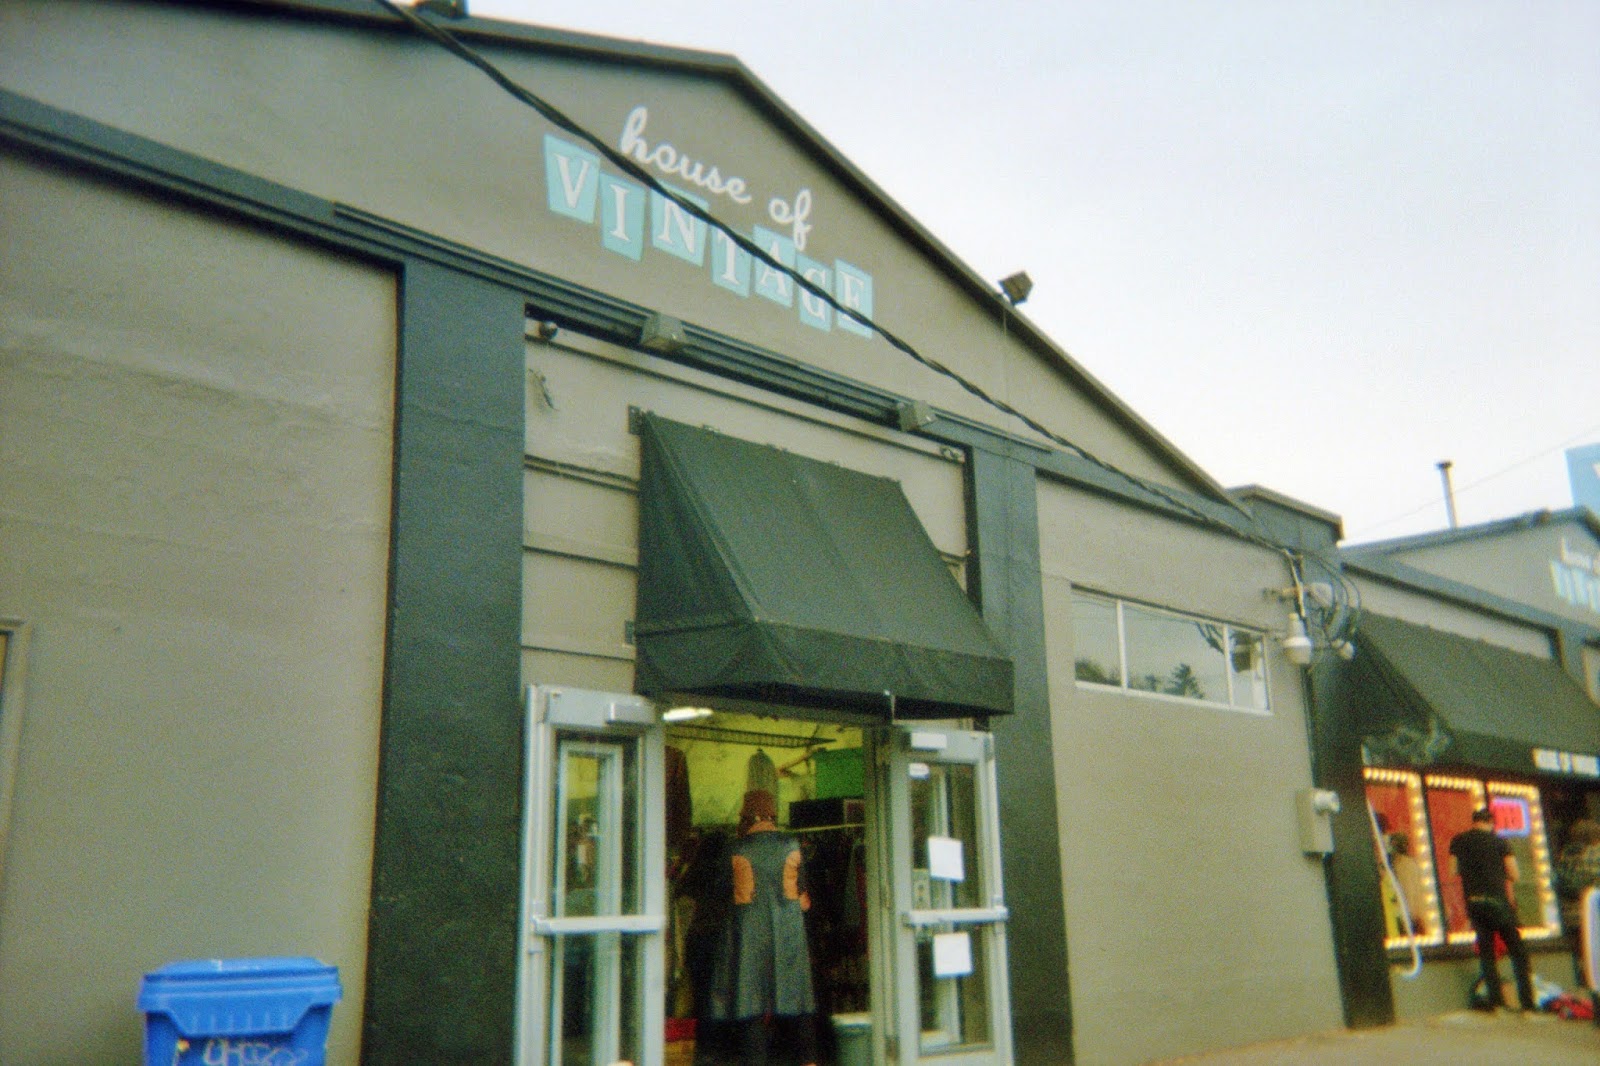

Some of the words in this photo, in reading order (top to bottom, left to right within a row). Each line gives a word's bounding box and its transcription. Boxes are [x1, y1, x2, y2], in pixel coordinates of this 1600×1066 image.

[553, 152, 866, 326] VINTAGE
[619, 105, 751, 204] house
[768, 188, 813, 252] of
